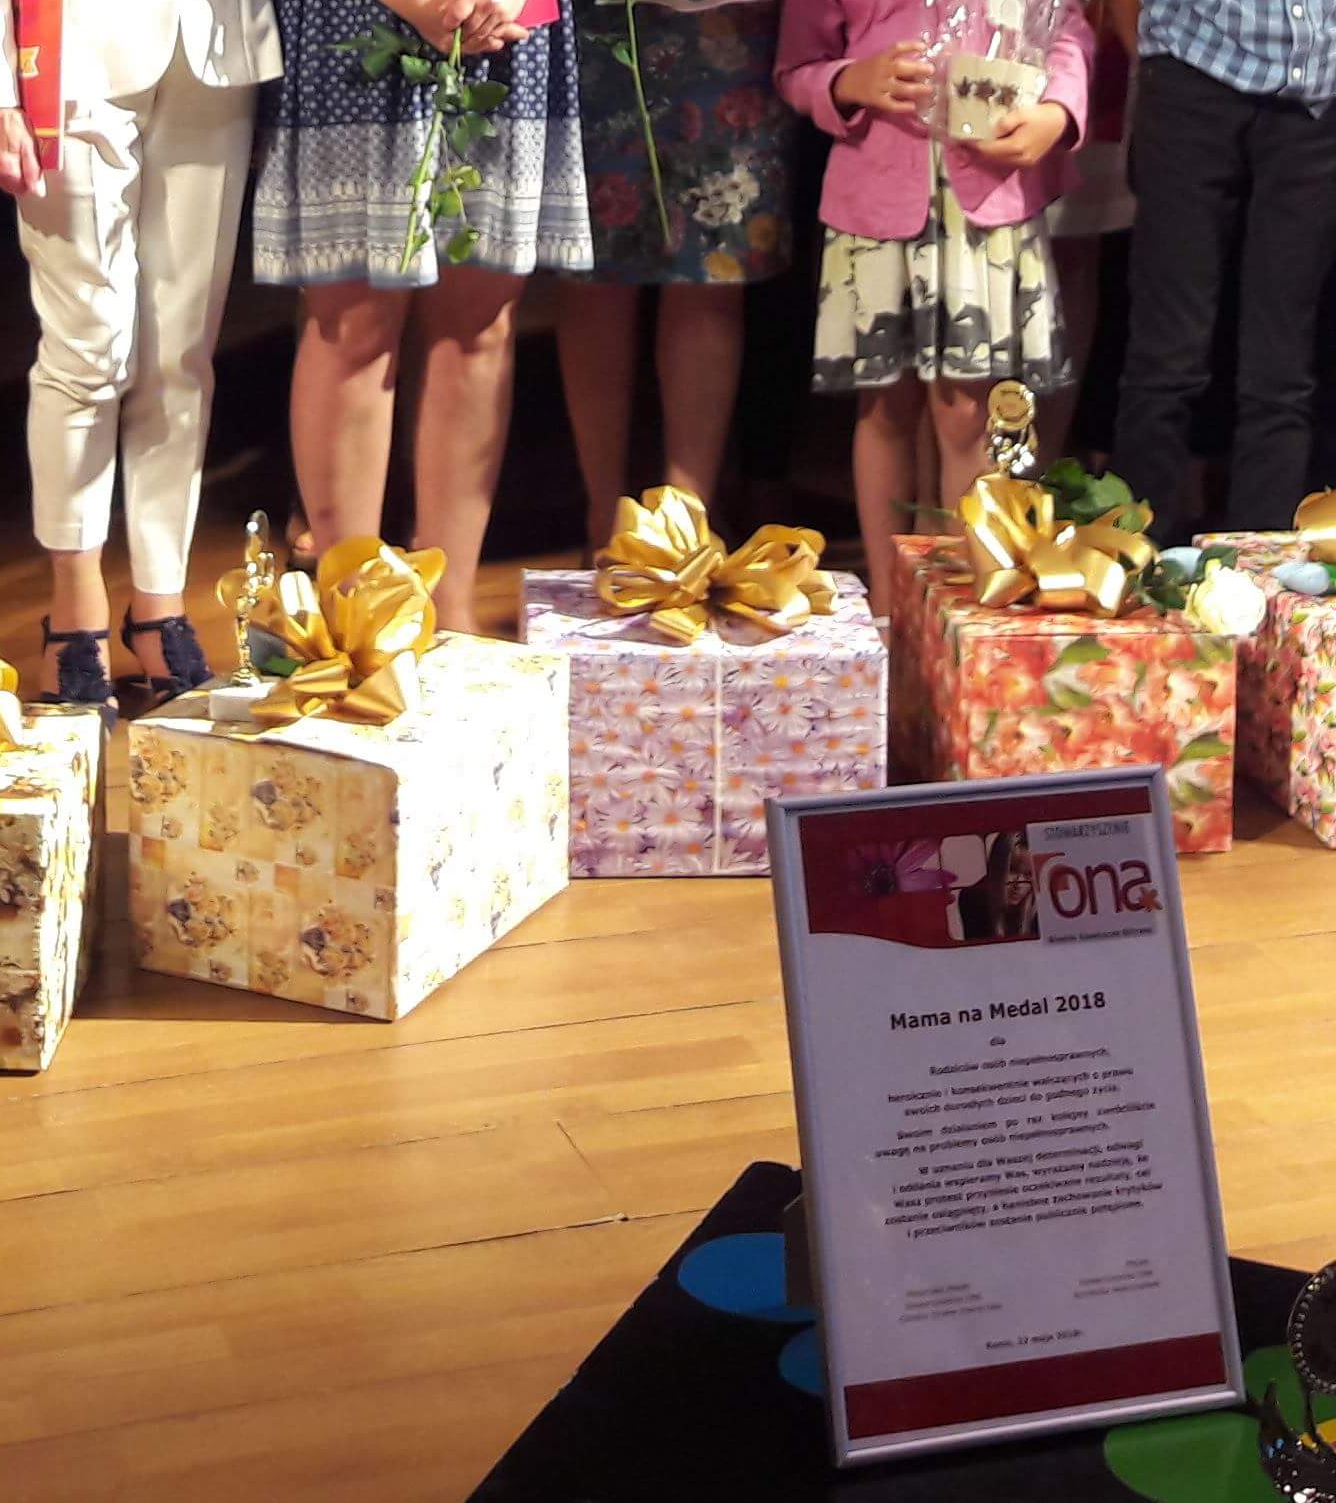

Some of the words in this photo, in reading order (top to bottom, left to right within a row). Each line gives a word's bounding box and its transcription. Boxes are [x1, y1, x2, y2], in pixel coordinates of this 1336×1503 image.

[890, 1007, 951, 1032] Mama
[958, 1007, 982, 1024] na
[988, 995, 1048, 1020] Medal
[1054, 990, 1106, 1013] 2018
